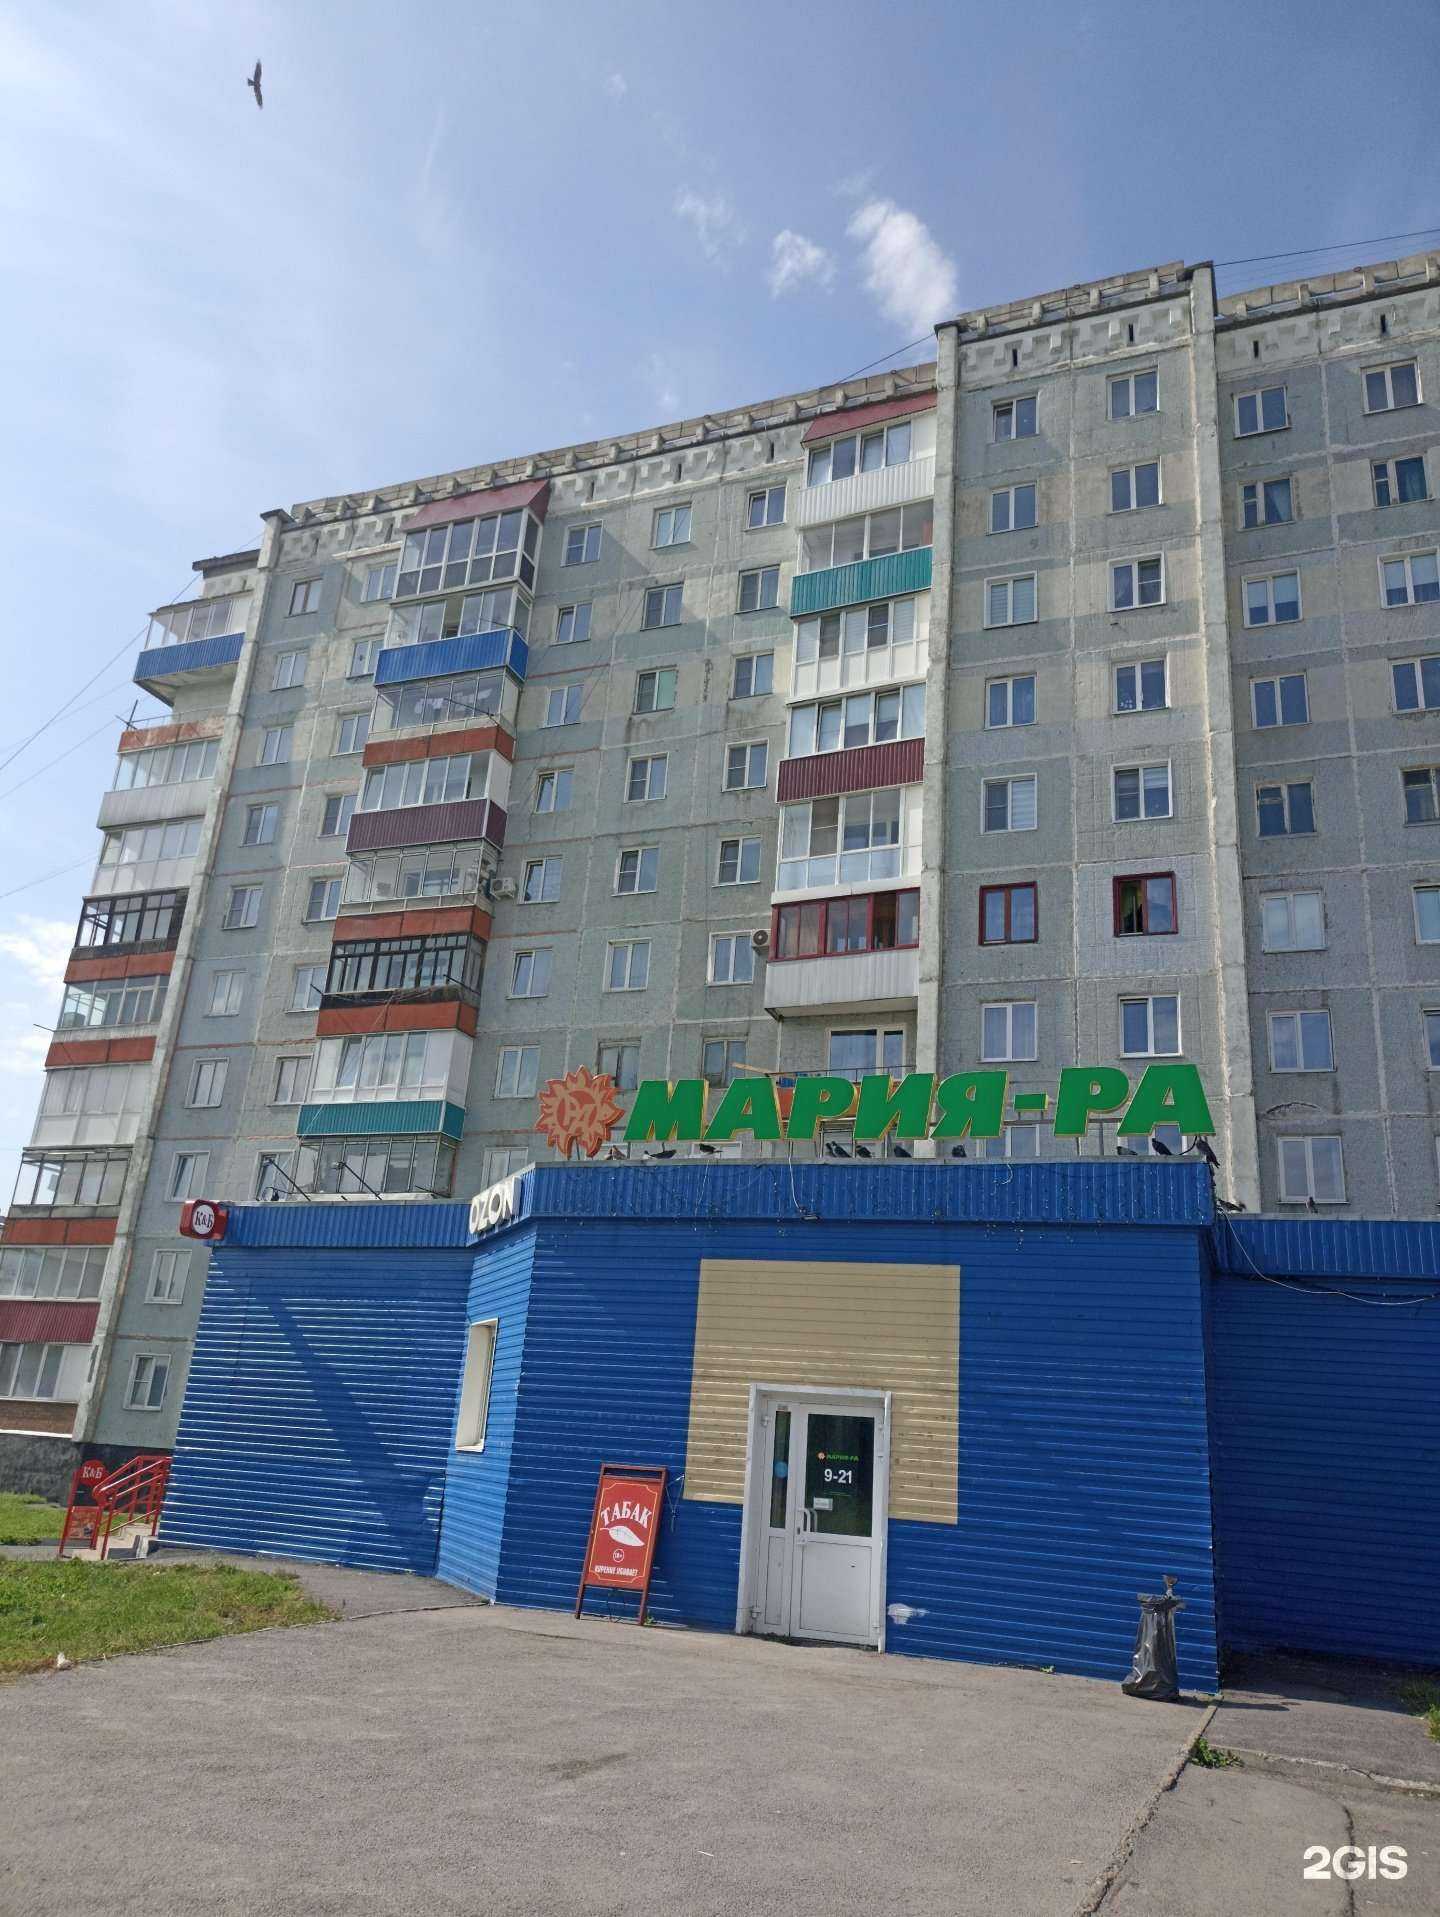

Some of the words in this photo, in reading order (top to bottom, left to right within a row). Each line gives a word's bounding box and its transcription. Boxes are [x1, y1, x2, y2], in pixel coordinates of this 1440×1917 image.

[623, 1064, 1216, 1142] МАРИЯ-РА
[195, 1210, 214, 1229] К&Б
[469, 1176, 520, 1234] OZON
[824, 1468, 853, 1484] 9-21
[600, 1500, 653, 1529] ТАБАК
